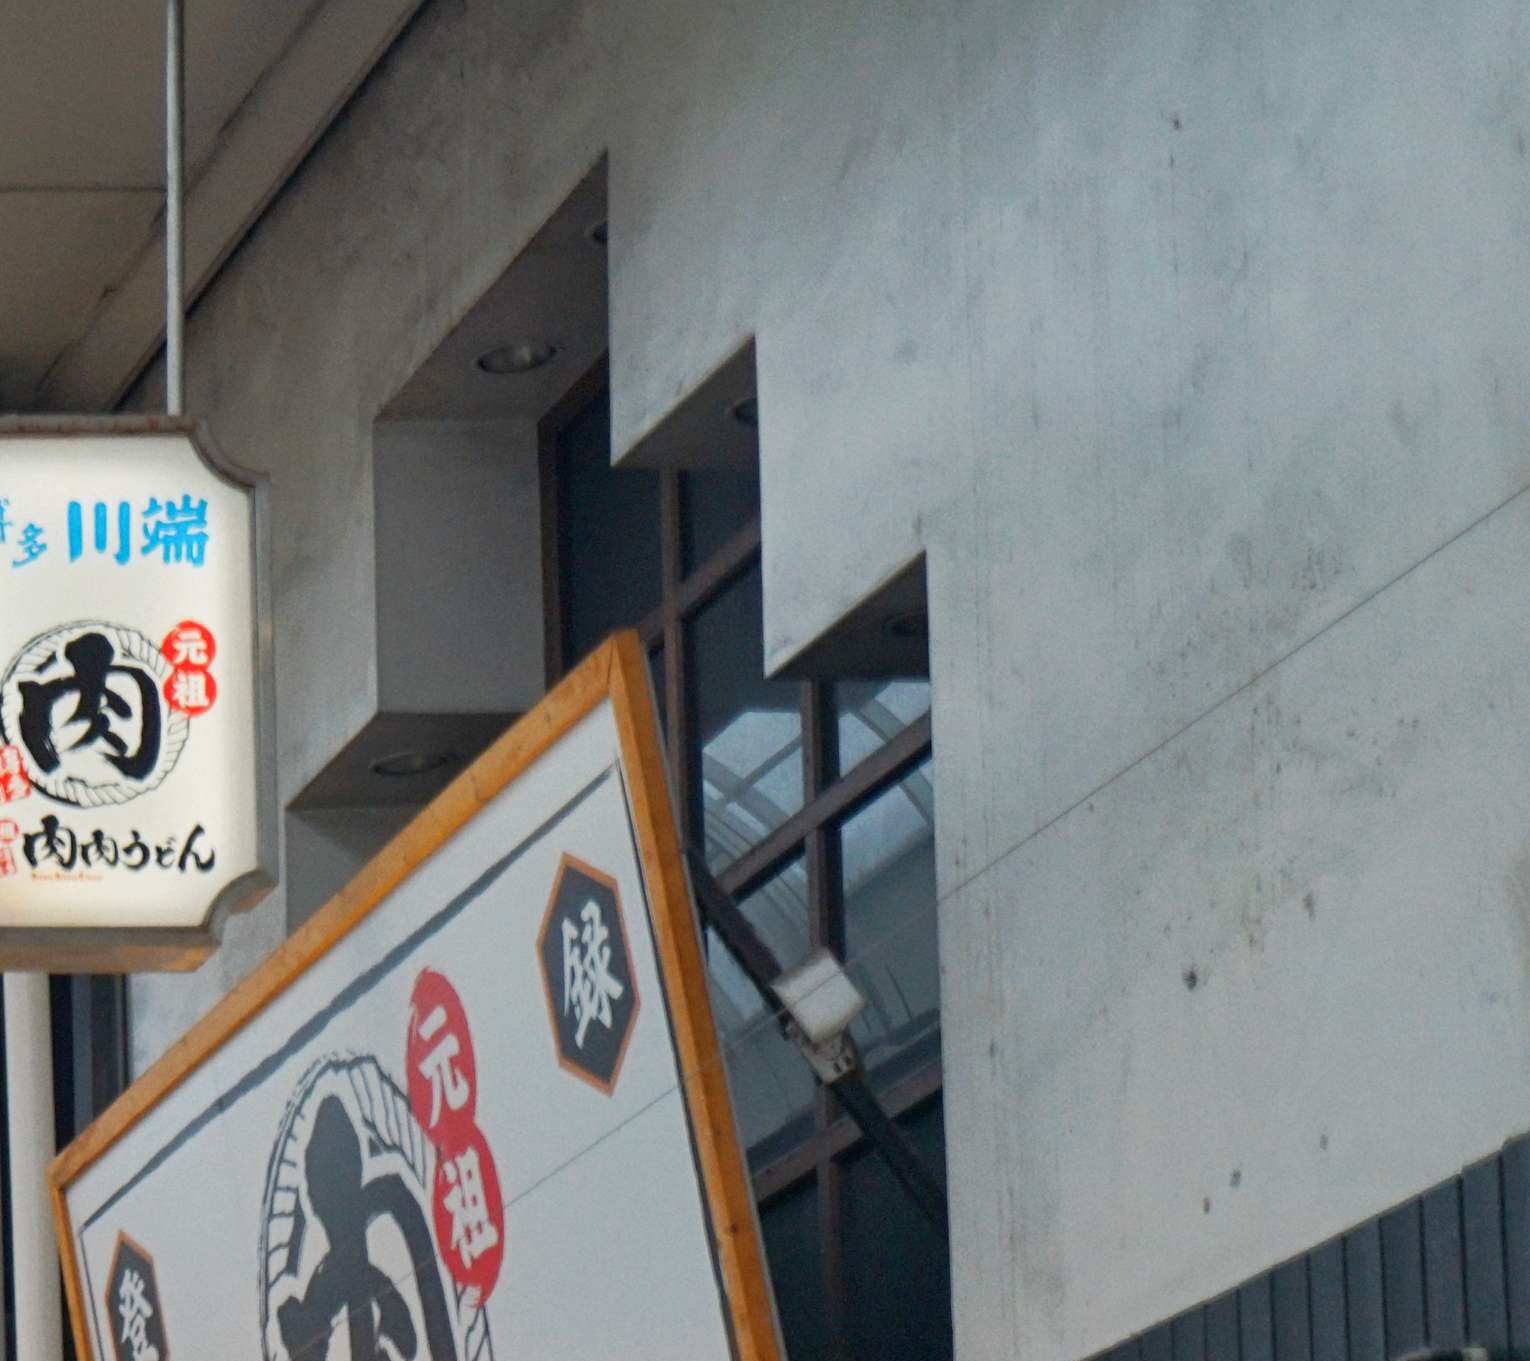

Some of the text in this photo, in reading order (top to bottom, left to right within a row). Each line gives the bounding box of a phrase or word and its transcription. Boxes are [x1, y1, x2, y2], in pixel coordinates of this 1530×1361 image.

[18, 632, 163, 782] 肉
[23, 813, 216, 873] 肉肉うどん
[413, 995, 500, 1266] 元祖
